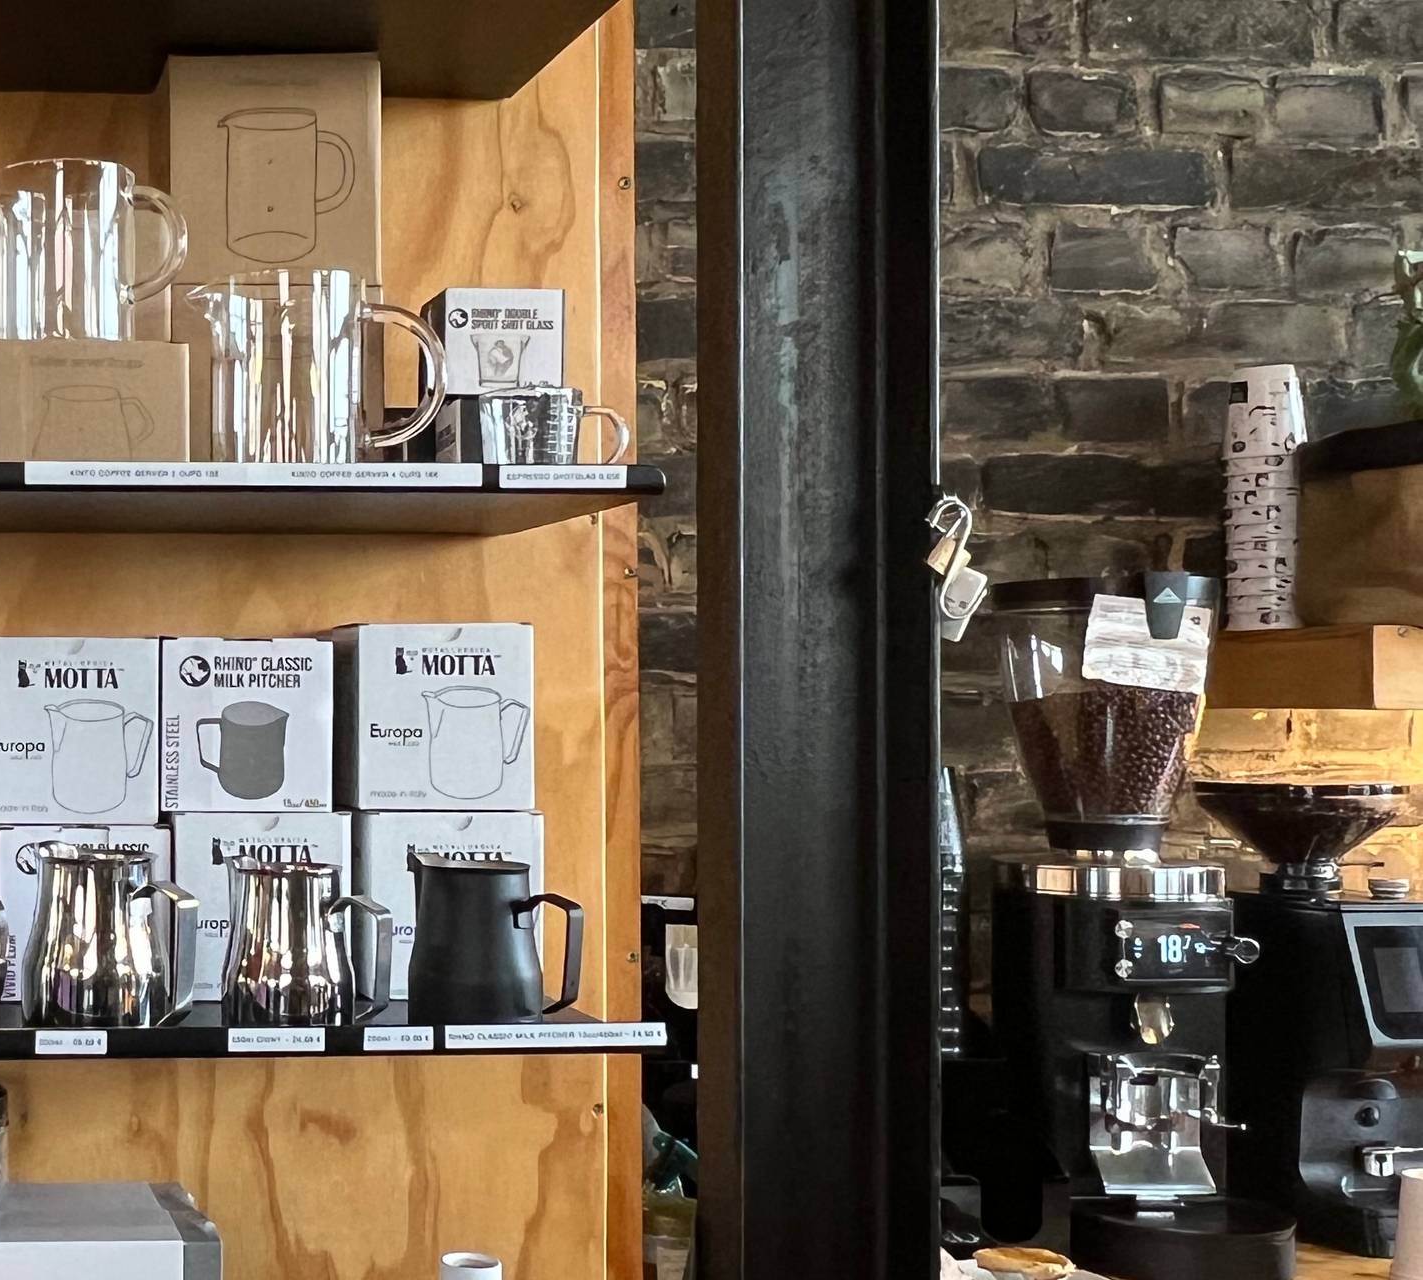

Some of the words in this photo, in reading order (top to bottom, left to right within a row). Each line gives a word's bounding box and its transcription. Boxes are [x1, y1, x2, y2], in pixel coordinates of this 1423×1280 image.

[501, 319, 524, 330] SHOT
[526, 320, 554, 330] GLASS
[98, 469, 131, 478] COFFEE
[320, 470, 352, 478] COFFEE
[261, 657, 313, 672] CLASSIC
[422, 654, 496, 676] MOTTA
[44, 668, 119, 689] MOTTA
[214, 673, 245, 688] MILK
[248, 673, 301, 689] PITCHER
[165, 715, 180, 749] STEEL
[370, 723, 423, 747] Europa
[165, 750, 180, 809] STAINLESS
